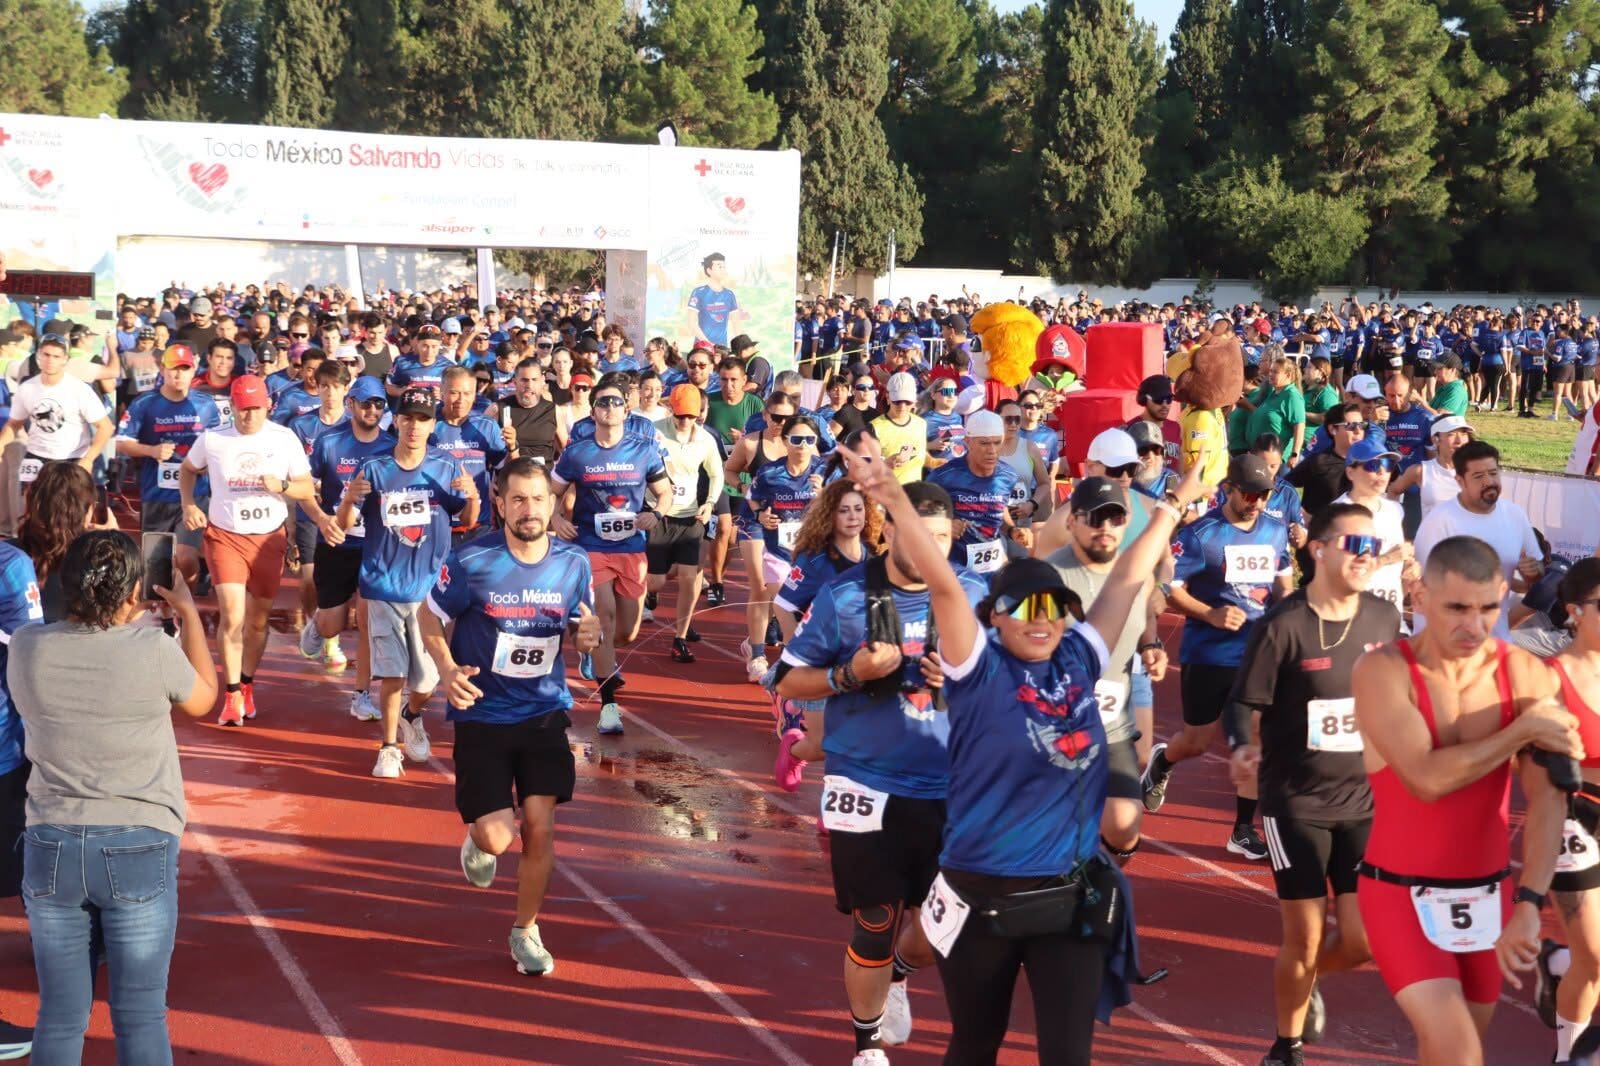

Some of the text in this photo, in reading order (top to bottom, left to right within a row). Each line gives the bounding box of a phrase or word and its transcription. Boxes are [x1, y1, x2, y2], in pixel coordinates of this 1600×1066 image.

[203, 137, 258, 158] Todo
[266, 139, 343, 166] México
[348, 143, 441, 169] Salvando
[449, 146, 504, 169] Vidas
[421, 224, 475, 234] alsuper
[608, 229, 631, 238] GCC
[606, 462, 634, 472] México
[240, 507, 270, 521] 901
[387, 500, 425, 515] 465
[602, 519, 633, 533] 565
[974, 549, 1000, 564] 263
[1236, 556, 1270, 570] 362
[489, 589, 562, 604] Todo México
[484, 603, 536, 618] Salvando
[904, 620, 928, 638] Mé
[511, 648, 544, 666] 68
[825, 790, 875, 817] 285
[1450, 902, 1473, 930] 5
